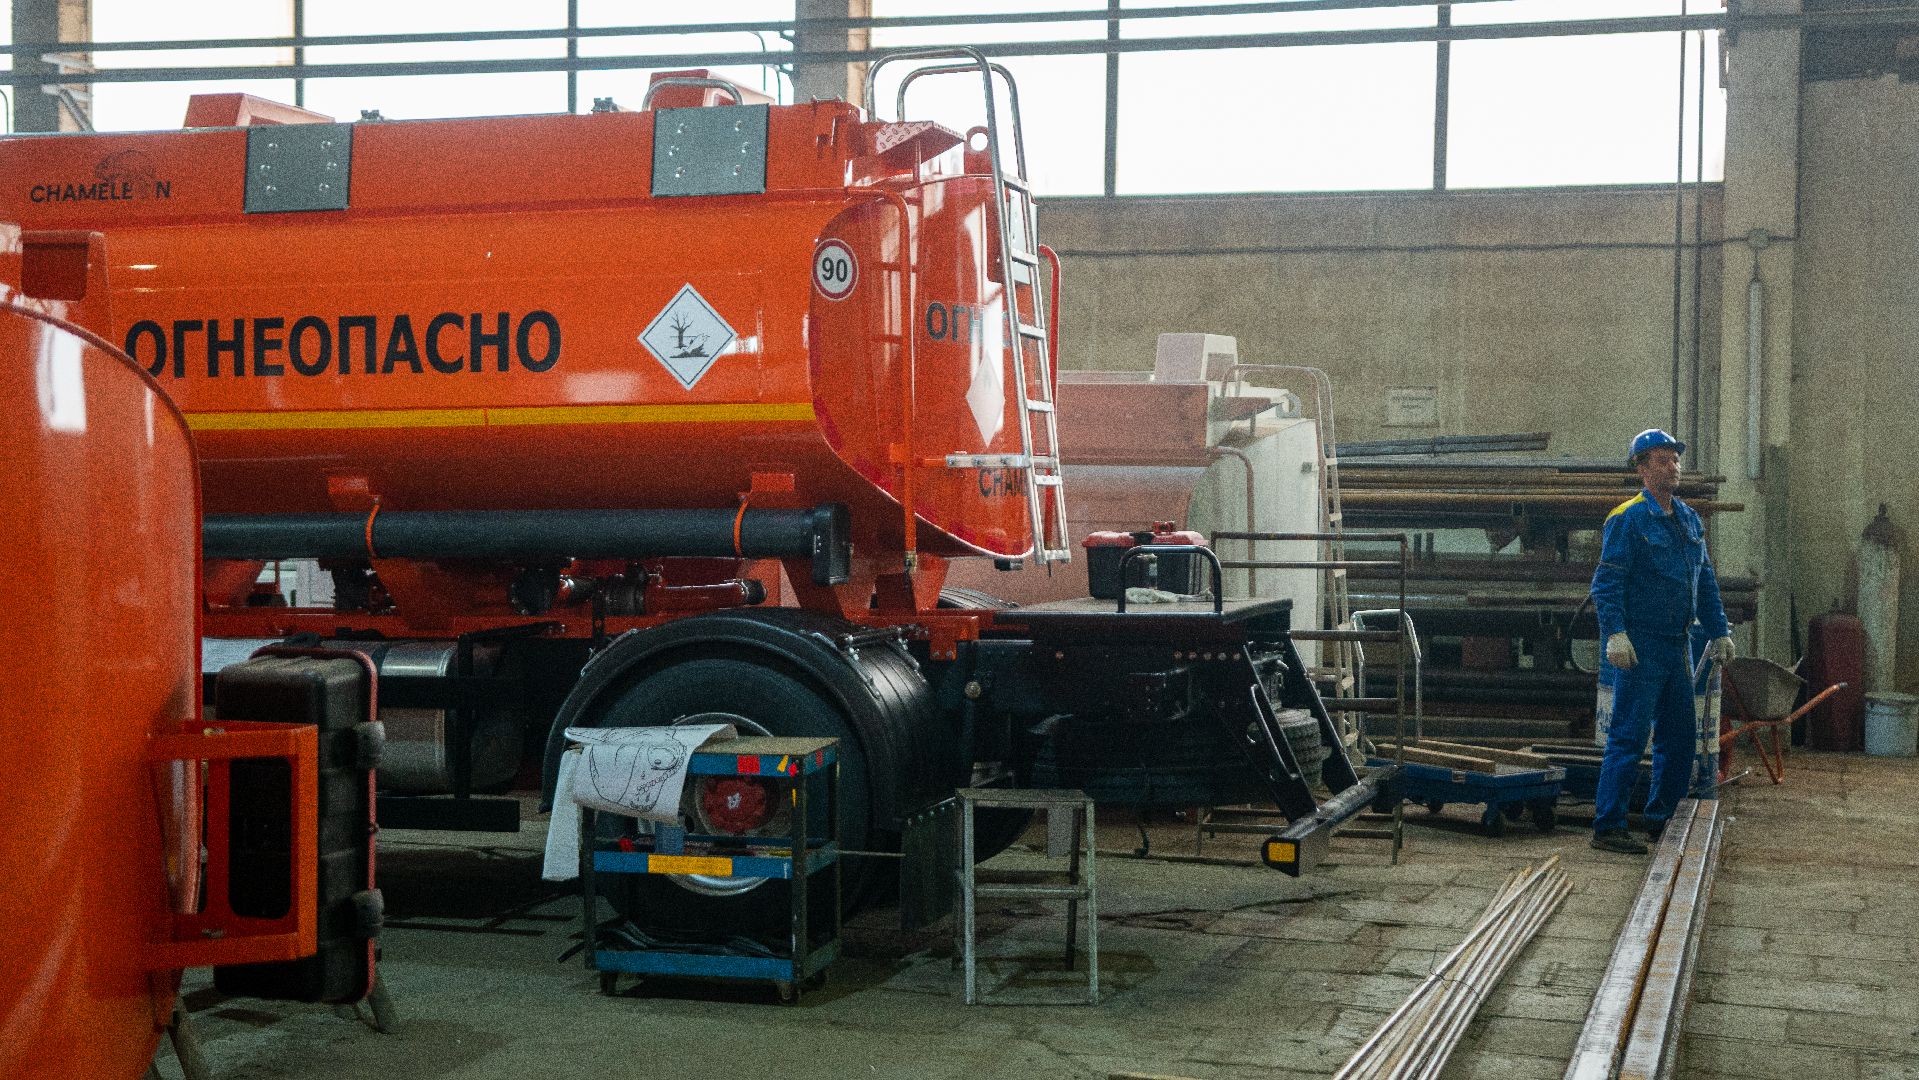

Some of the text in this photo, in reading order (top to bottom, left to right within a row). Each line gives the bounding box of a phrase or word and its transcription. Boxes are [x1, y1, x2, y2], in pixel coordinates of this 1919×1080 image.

[30, 180, 171, 202] CHAMELEN
[822, 257, 848, 282] 90
[125, 309, 562, 378] ОГНЕОПАСНО
